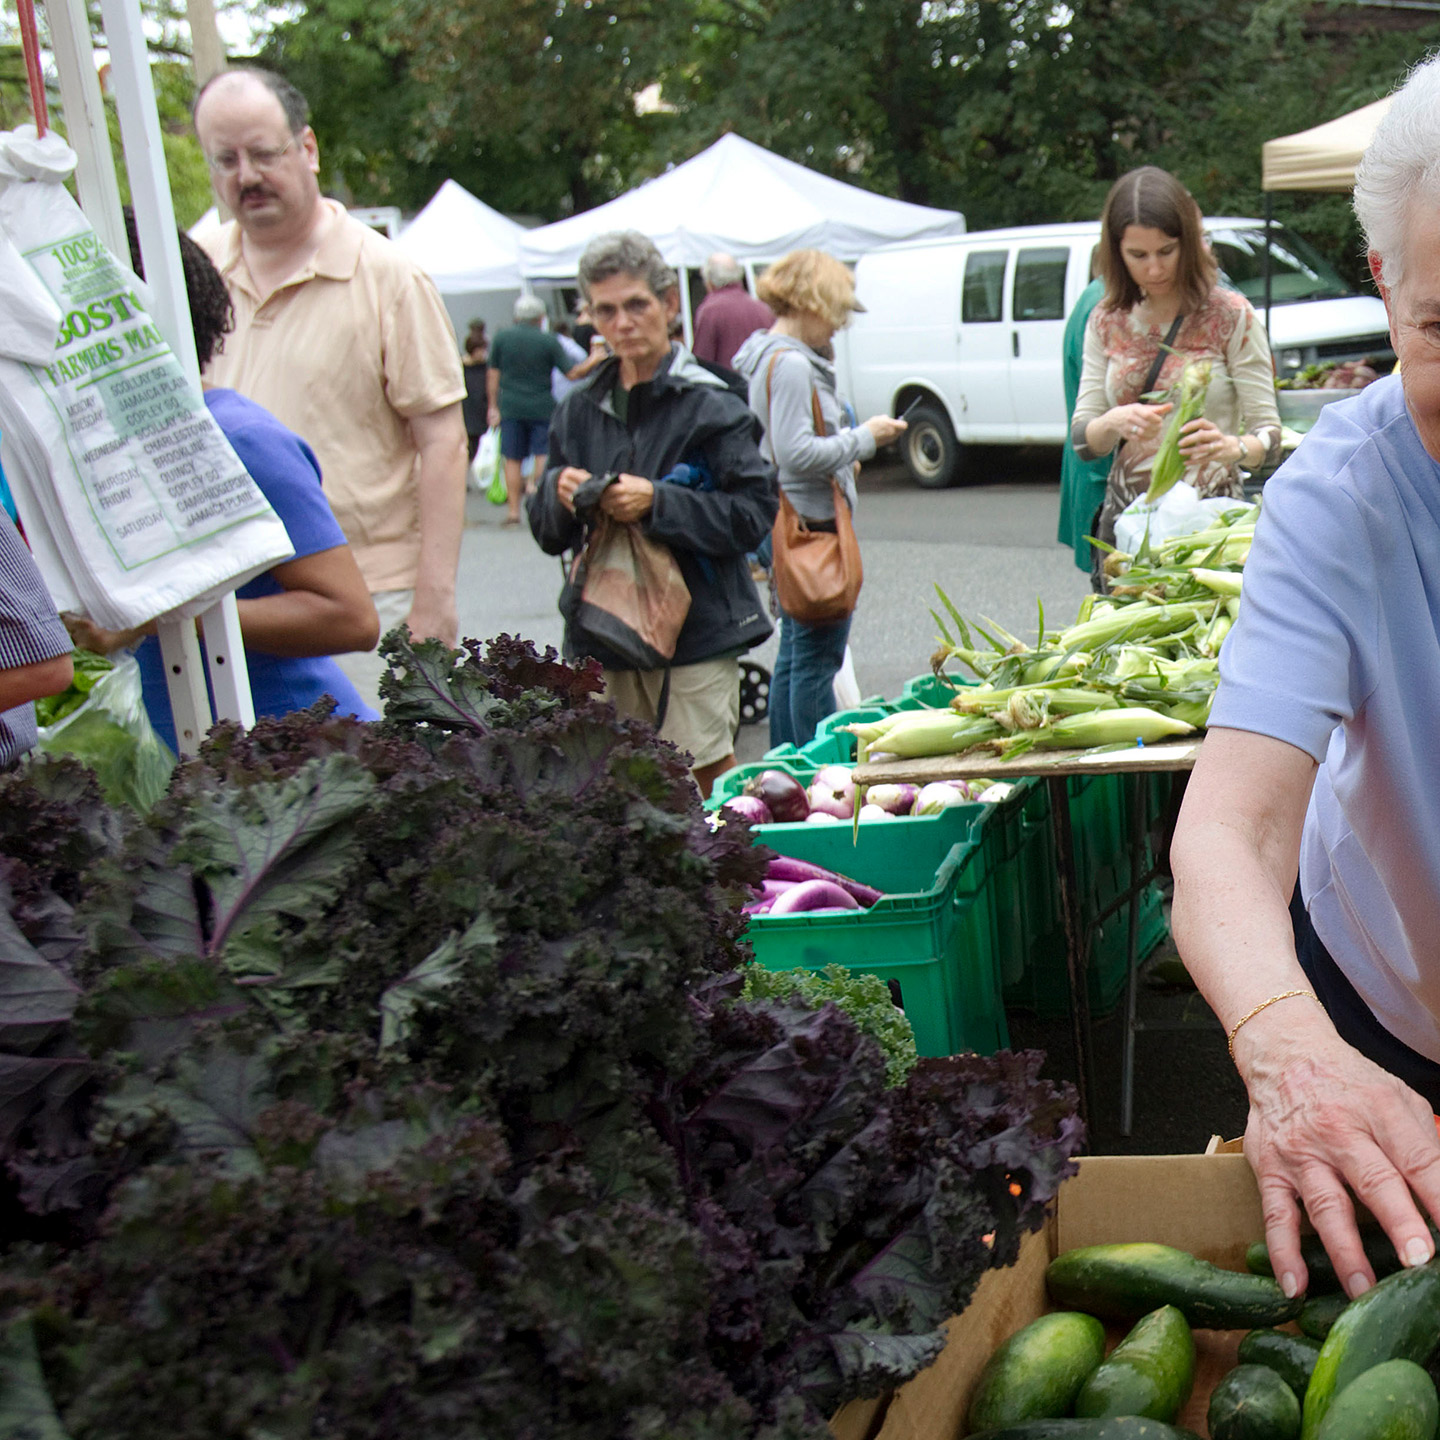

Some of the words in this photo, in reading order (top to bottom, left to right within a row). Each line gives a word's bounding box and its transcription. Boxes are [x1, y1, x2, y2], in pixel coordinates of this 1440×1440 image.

[51, 234, 107, 268] 100%
[43, 338, 123, 387] FARMERS
[123, 322, 162, 353] MA
[66, 395, 95, 417] MONDAY
[110, 371, 150, 397] SCOLLAY
[70, 410, 103, 433] TUESDAY
[119, 385, 160, 412] JAMAICA
[160, 375, 188, 394] PLAIN
[126, 402, 163, 427] COPLEY
[82, 435, 130, 464] WEDNESDAY
[135, 416, 176, 440] SCOLLAY
[143, 419, 213, 454] CHARLESTOWN
[93, 466, 141, 494] THURSDAY
[152, 439, 206, 469] BROOKLINE
[99, 487, 133, 510] FRIDAY
[160, 460, 195, 484] QUINCY
[168, 474, 204, 498] COPLEY
[116, 510, 164, 539] SATURDAY
[186, 502, 225, 527] JAMAICA
[225, 490, 253, 508] PLAIN
